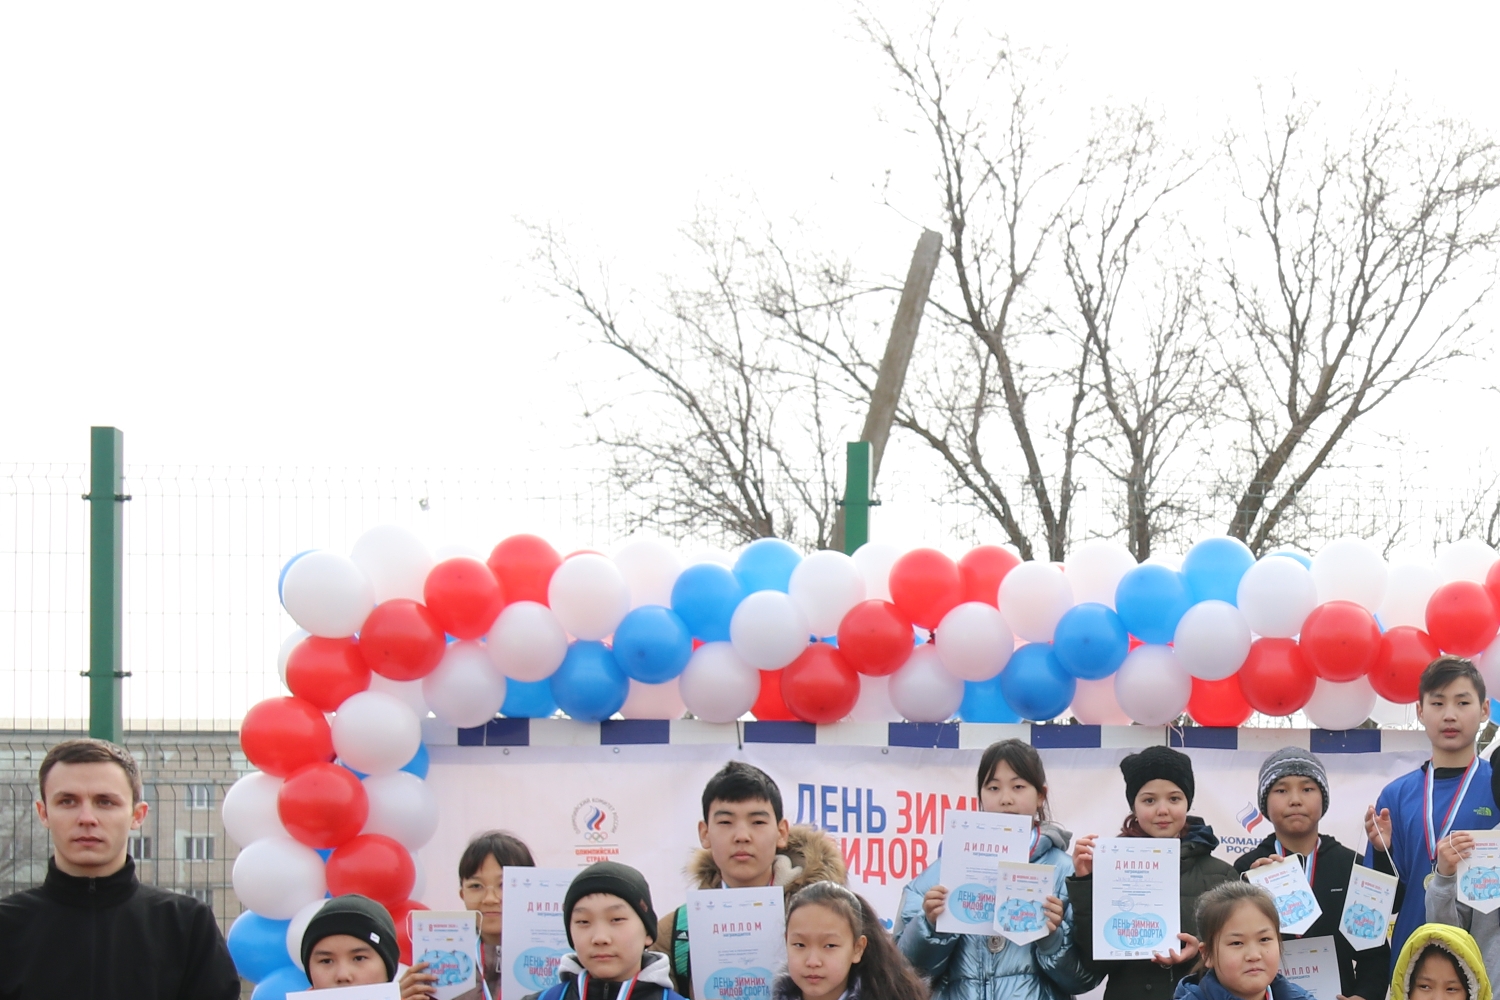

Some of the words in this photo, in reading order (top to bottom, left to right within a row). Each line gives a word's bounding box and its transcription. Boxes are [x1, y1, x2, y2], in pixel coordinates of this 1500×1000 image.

[794, 783, 887, 834] ДЕНЬ
[1220, 836, 1263, 846] КОМАН
[575, 847, 619, 856] ОЛИМПИЙСКАЯ
[964, 842, 1009, 854] ДИПЛОМ
[840, 837, 929, 885] ИДОВ
[1115, 861, 1159, 870] ДИПЛОМ
[712, 922, 762, 935] ДИПЛОМ
